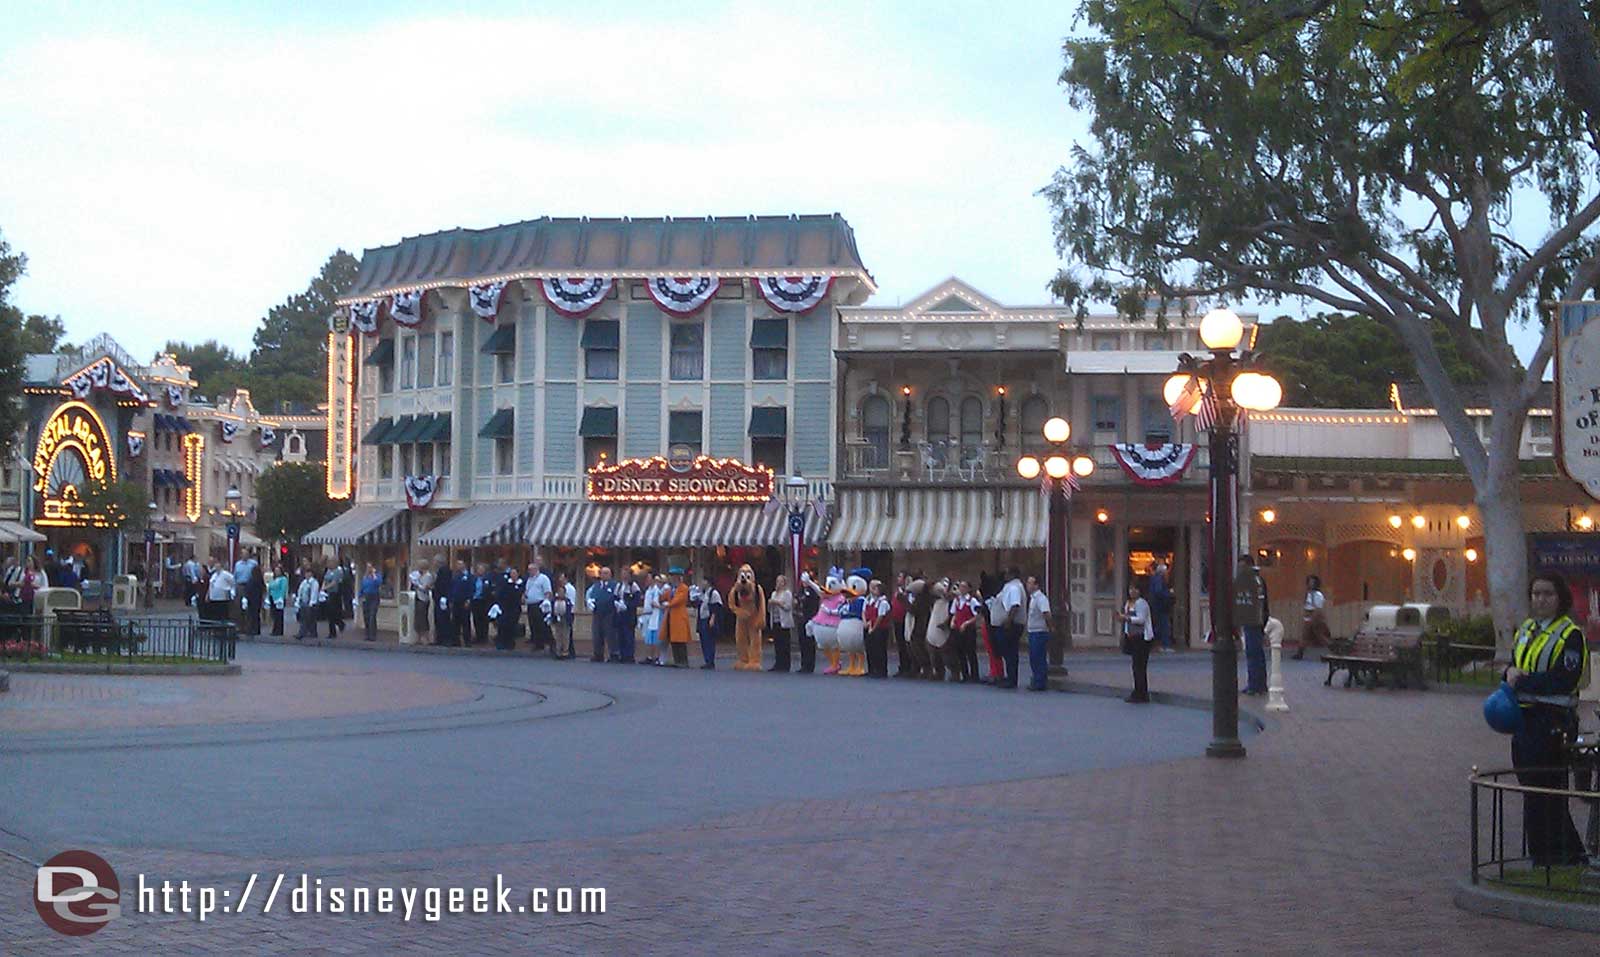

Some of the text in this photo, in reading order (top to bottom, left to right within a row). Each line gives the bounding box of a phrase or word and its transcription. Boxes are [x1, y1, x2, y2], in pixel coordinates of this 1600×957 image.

[335, 341, 346, 465] MAIN STREET
[72, 415, 106, 482] ARCAD
[603, 478, 758, 493] DISNEY SHOWCASE
